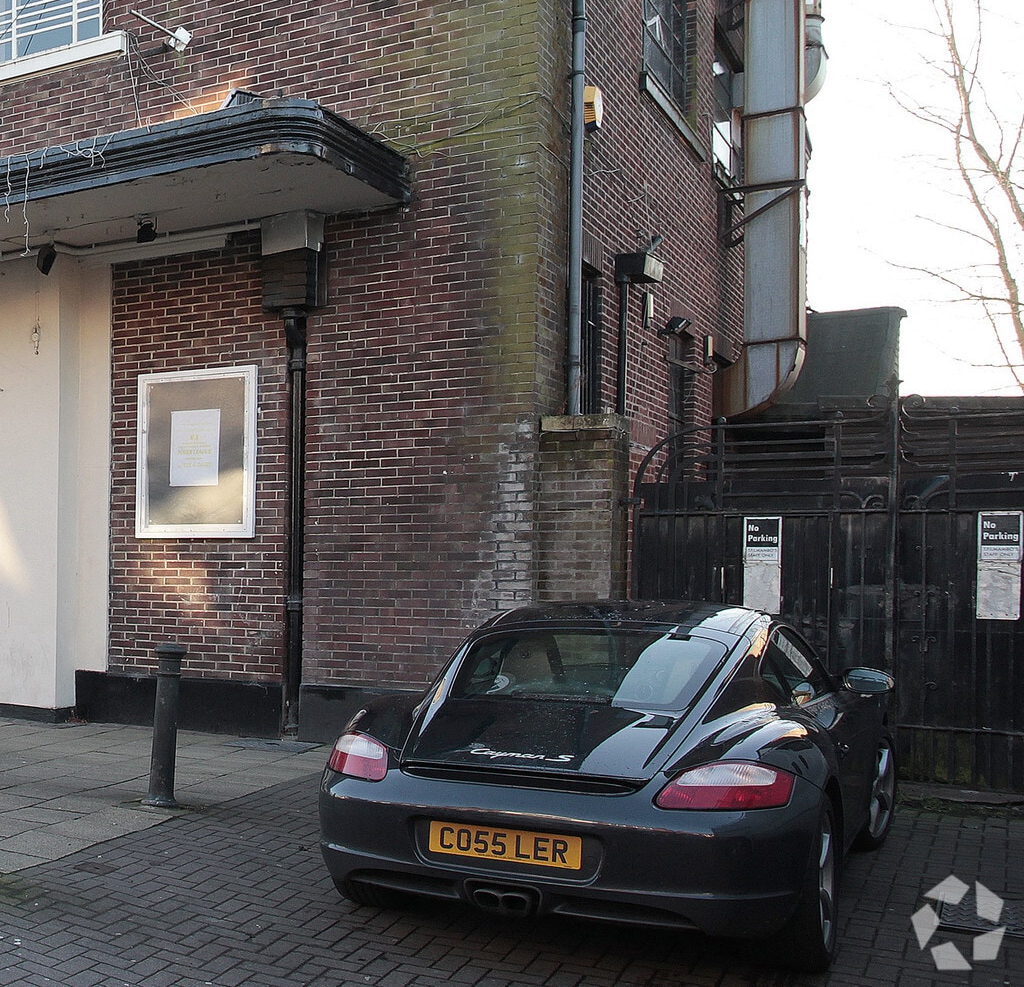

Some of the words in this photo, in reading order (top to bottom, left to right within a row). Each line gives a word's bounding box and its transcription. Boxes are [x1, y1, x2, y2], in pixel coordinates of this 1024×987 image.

[748, 524, 759, 532] No
[983, 521, 996, 529] No
[748, 534, 778, 544] Parking
[983, 532, 1019, 542] Parking
[470, 748, 545, 759] Cayman
[545, 754, 575, 762] S
[439, 826, 507, 856] CO55
[515, 834, 568, 864] LER
